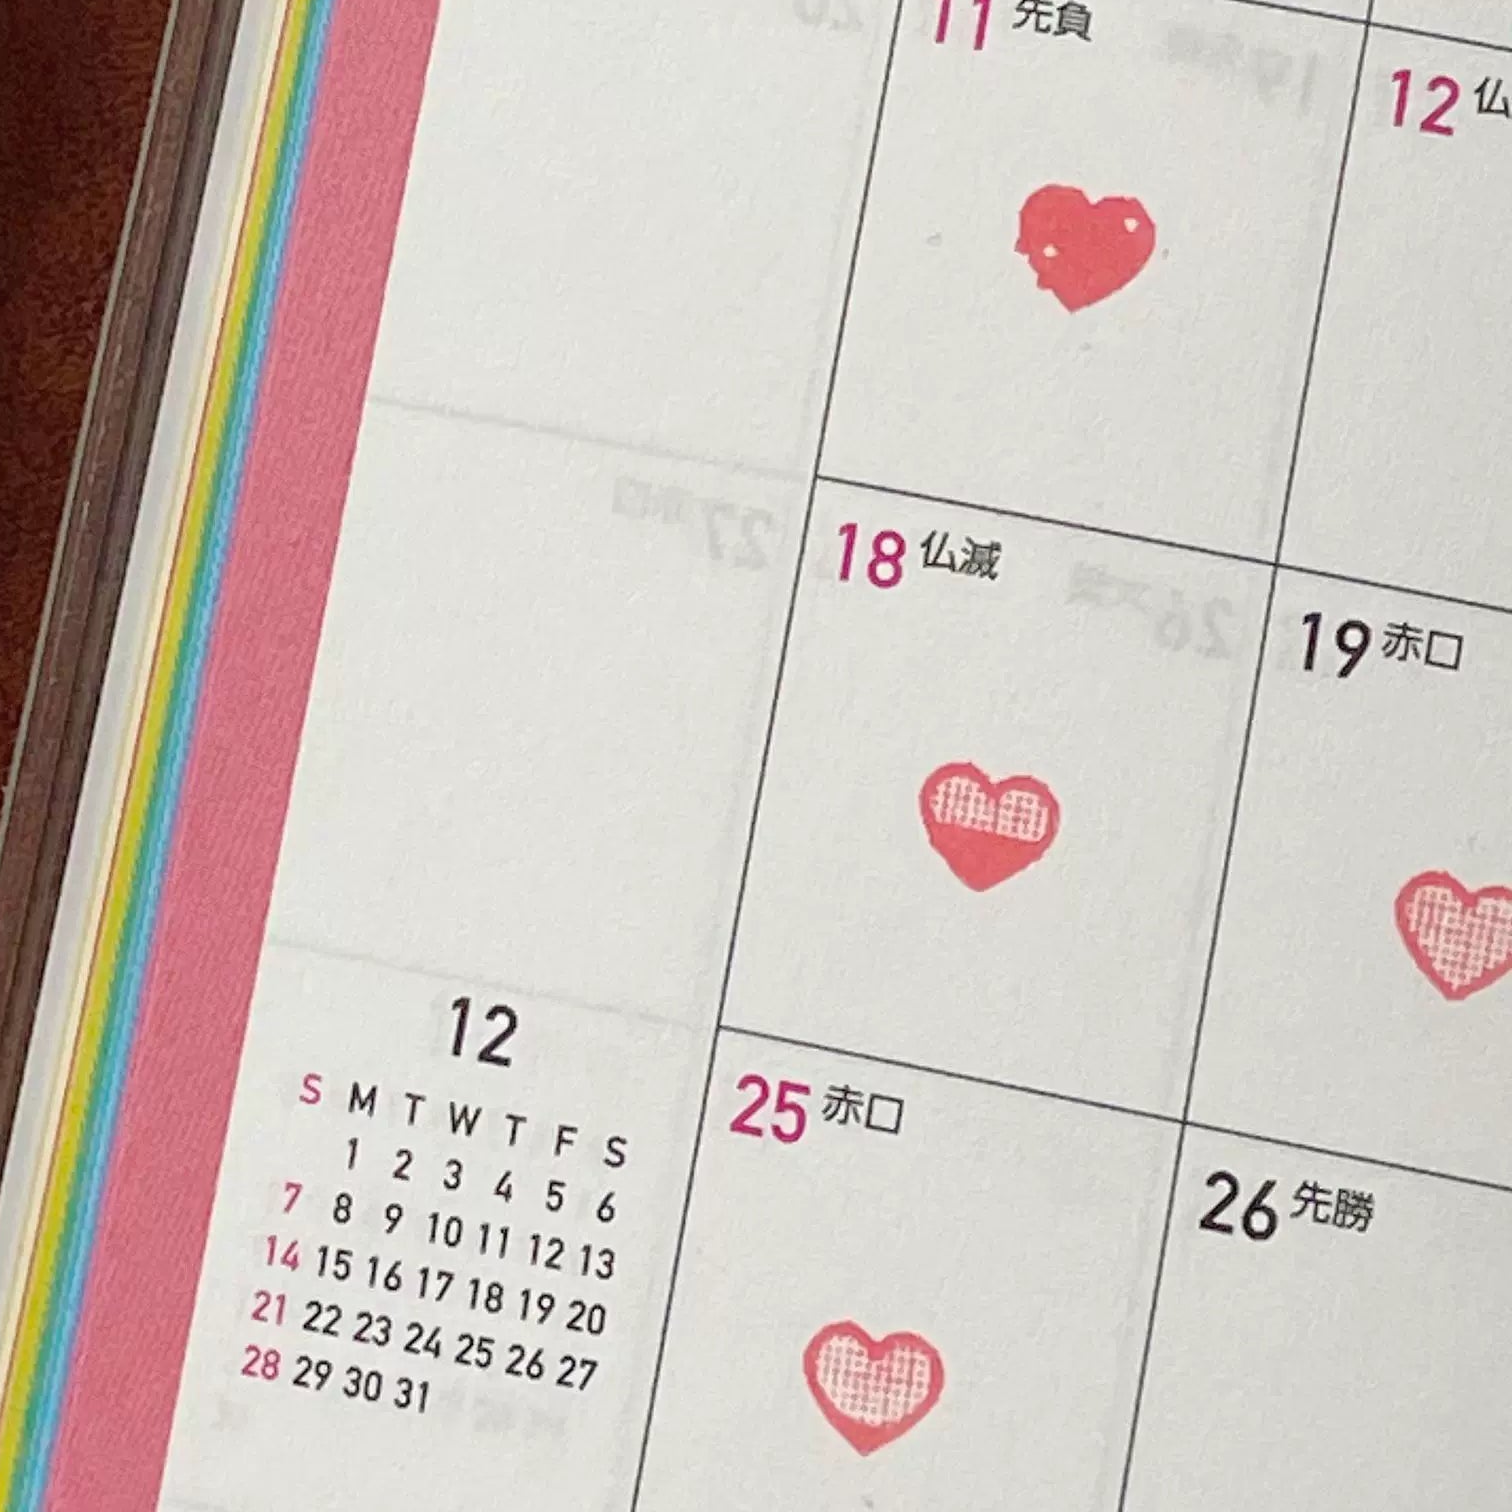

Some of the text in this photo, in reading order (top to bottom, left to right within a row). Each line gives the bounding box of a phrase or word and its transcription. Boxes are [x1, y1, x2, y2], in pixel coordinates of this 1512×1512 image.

[1392, 69, 1460, 136] 12
[839, 523, 1001, 589] 18 仏滅
[1302, 612, 1464, 678] 19 赤口
[452, 997, 517, 1068] 12
[299, 1073, 627, 1168] S M T W T F S
[730, 1074, 904, 1144] 25 赤口
[348, 1138, 615, 1223] 1 2 3 4 5 6
[1199, 1170, 1374, 1241] 26 先勝
[284, 1182, 615, 1280] 7 8 9 10 11 12 13
[268, 1235, 606, 1335] 14 15 16 17 18 19 20
[252, 1290, 598, 1391] 21 22 23 24 25 26 27
[242, 1345, 281, 1380] 28
[293, 1355, 333, 1391] 29
[342, 1366, 383, 1402] 30
[394, 1377, 429, 1413] 31
